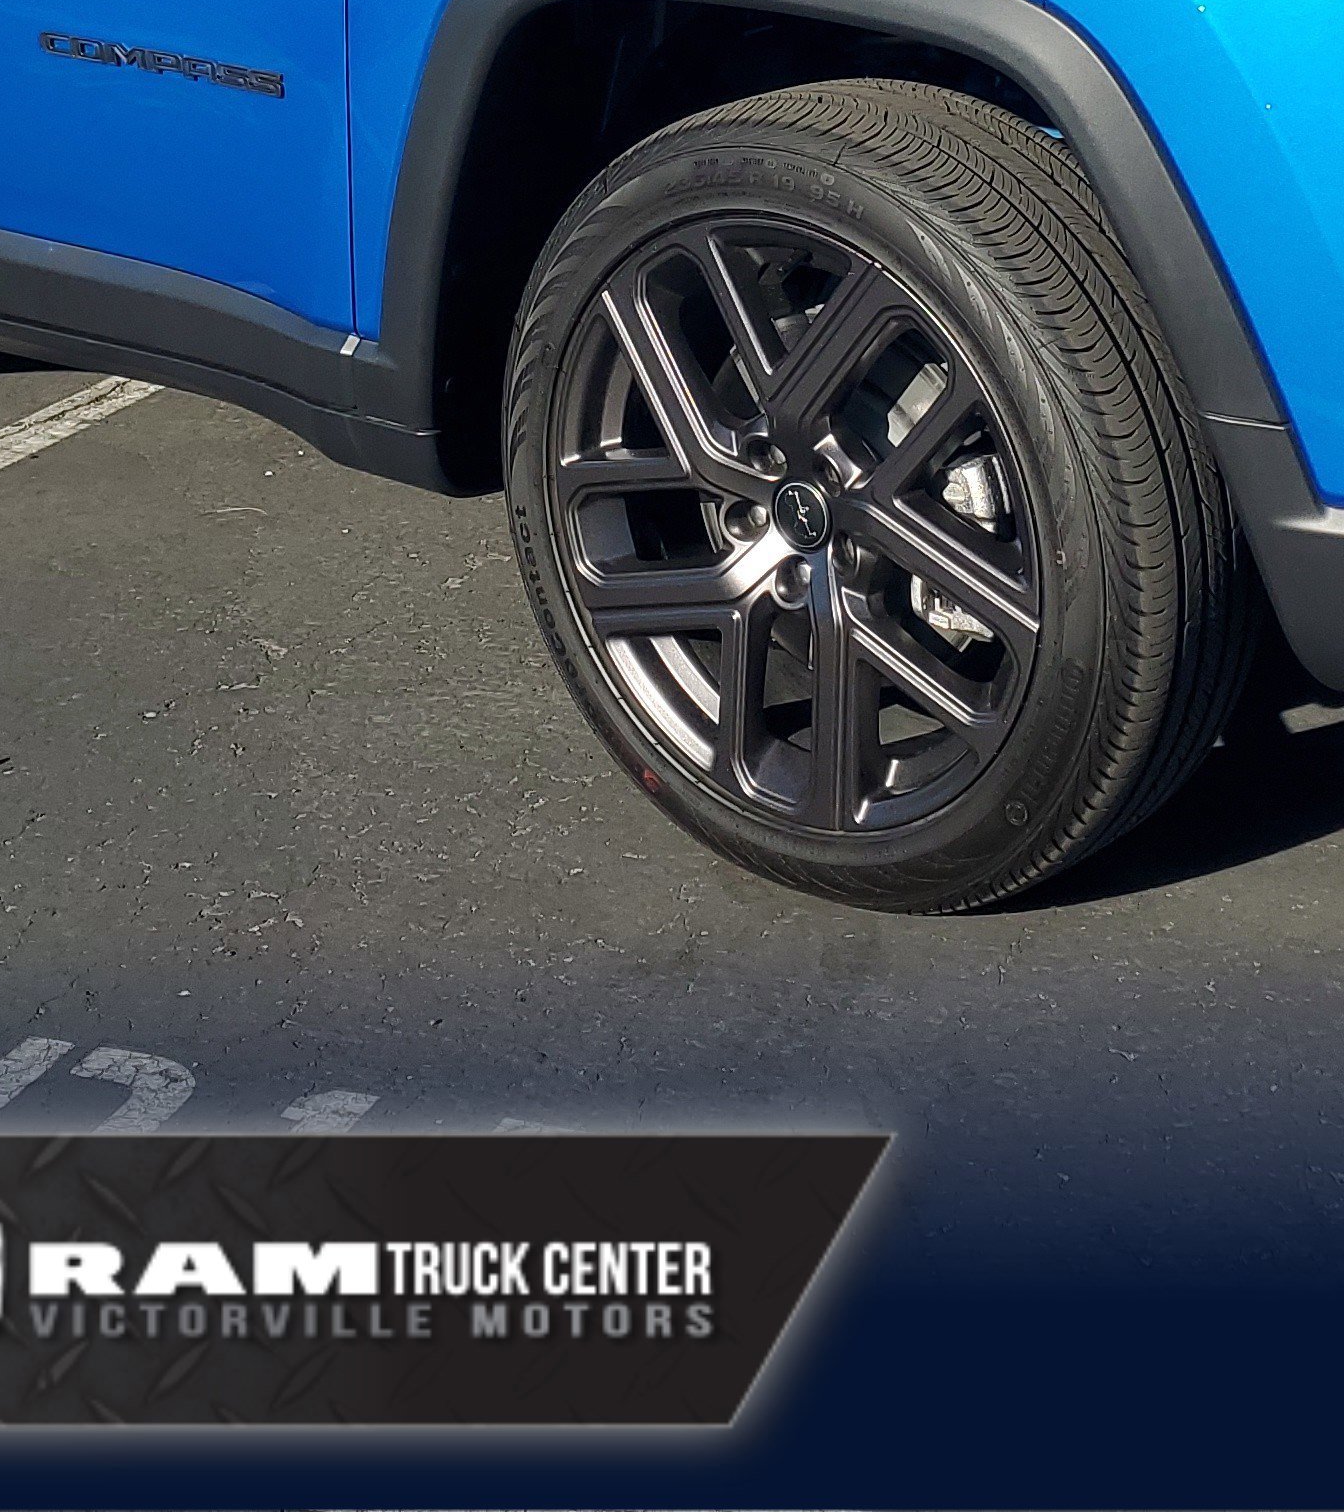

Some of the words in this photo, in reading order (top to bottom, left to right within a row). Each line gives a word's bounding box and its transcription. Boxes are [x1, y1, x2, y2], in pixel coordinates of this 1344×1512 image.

[38, 31, 286, 99] COMPASS
[772, 173, 796, 192] 19
[809, 184, 841, 208] 95
[846, 199, 864, 220] H
